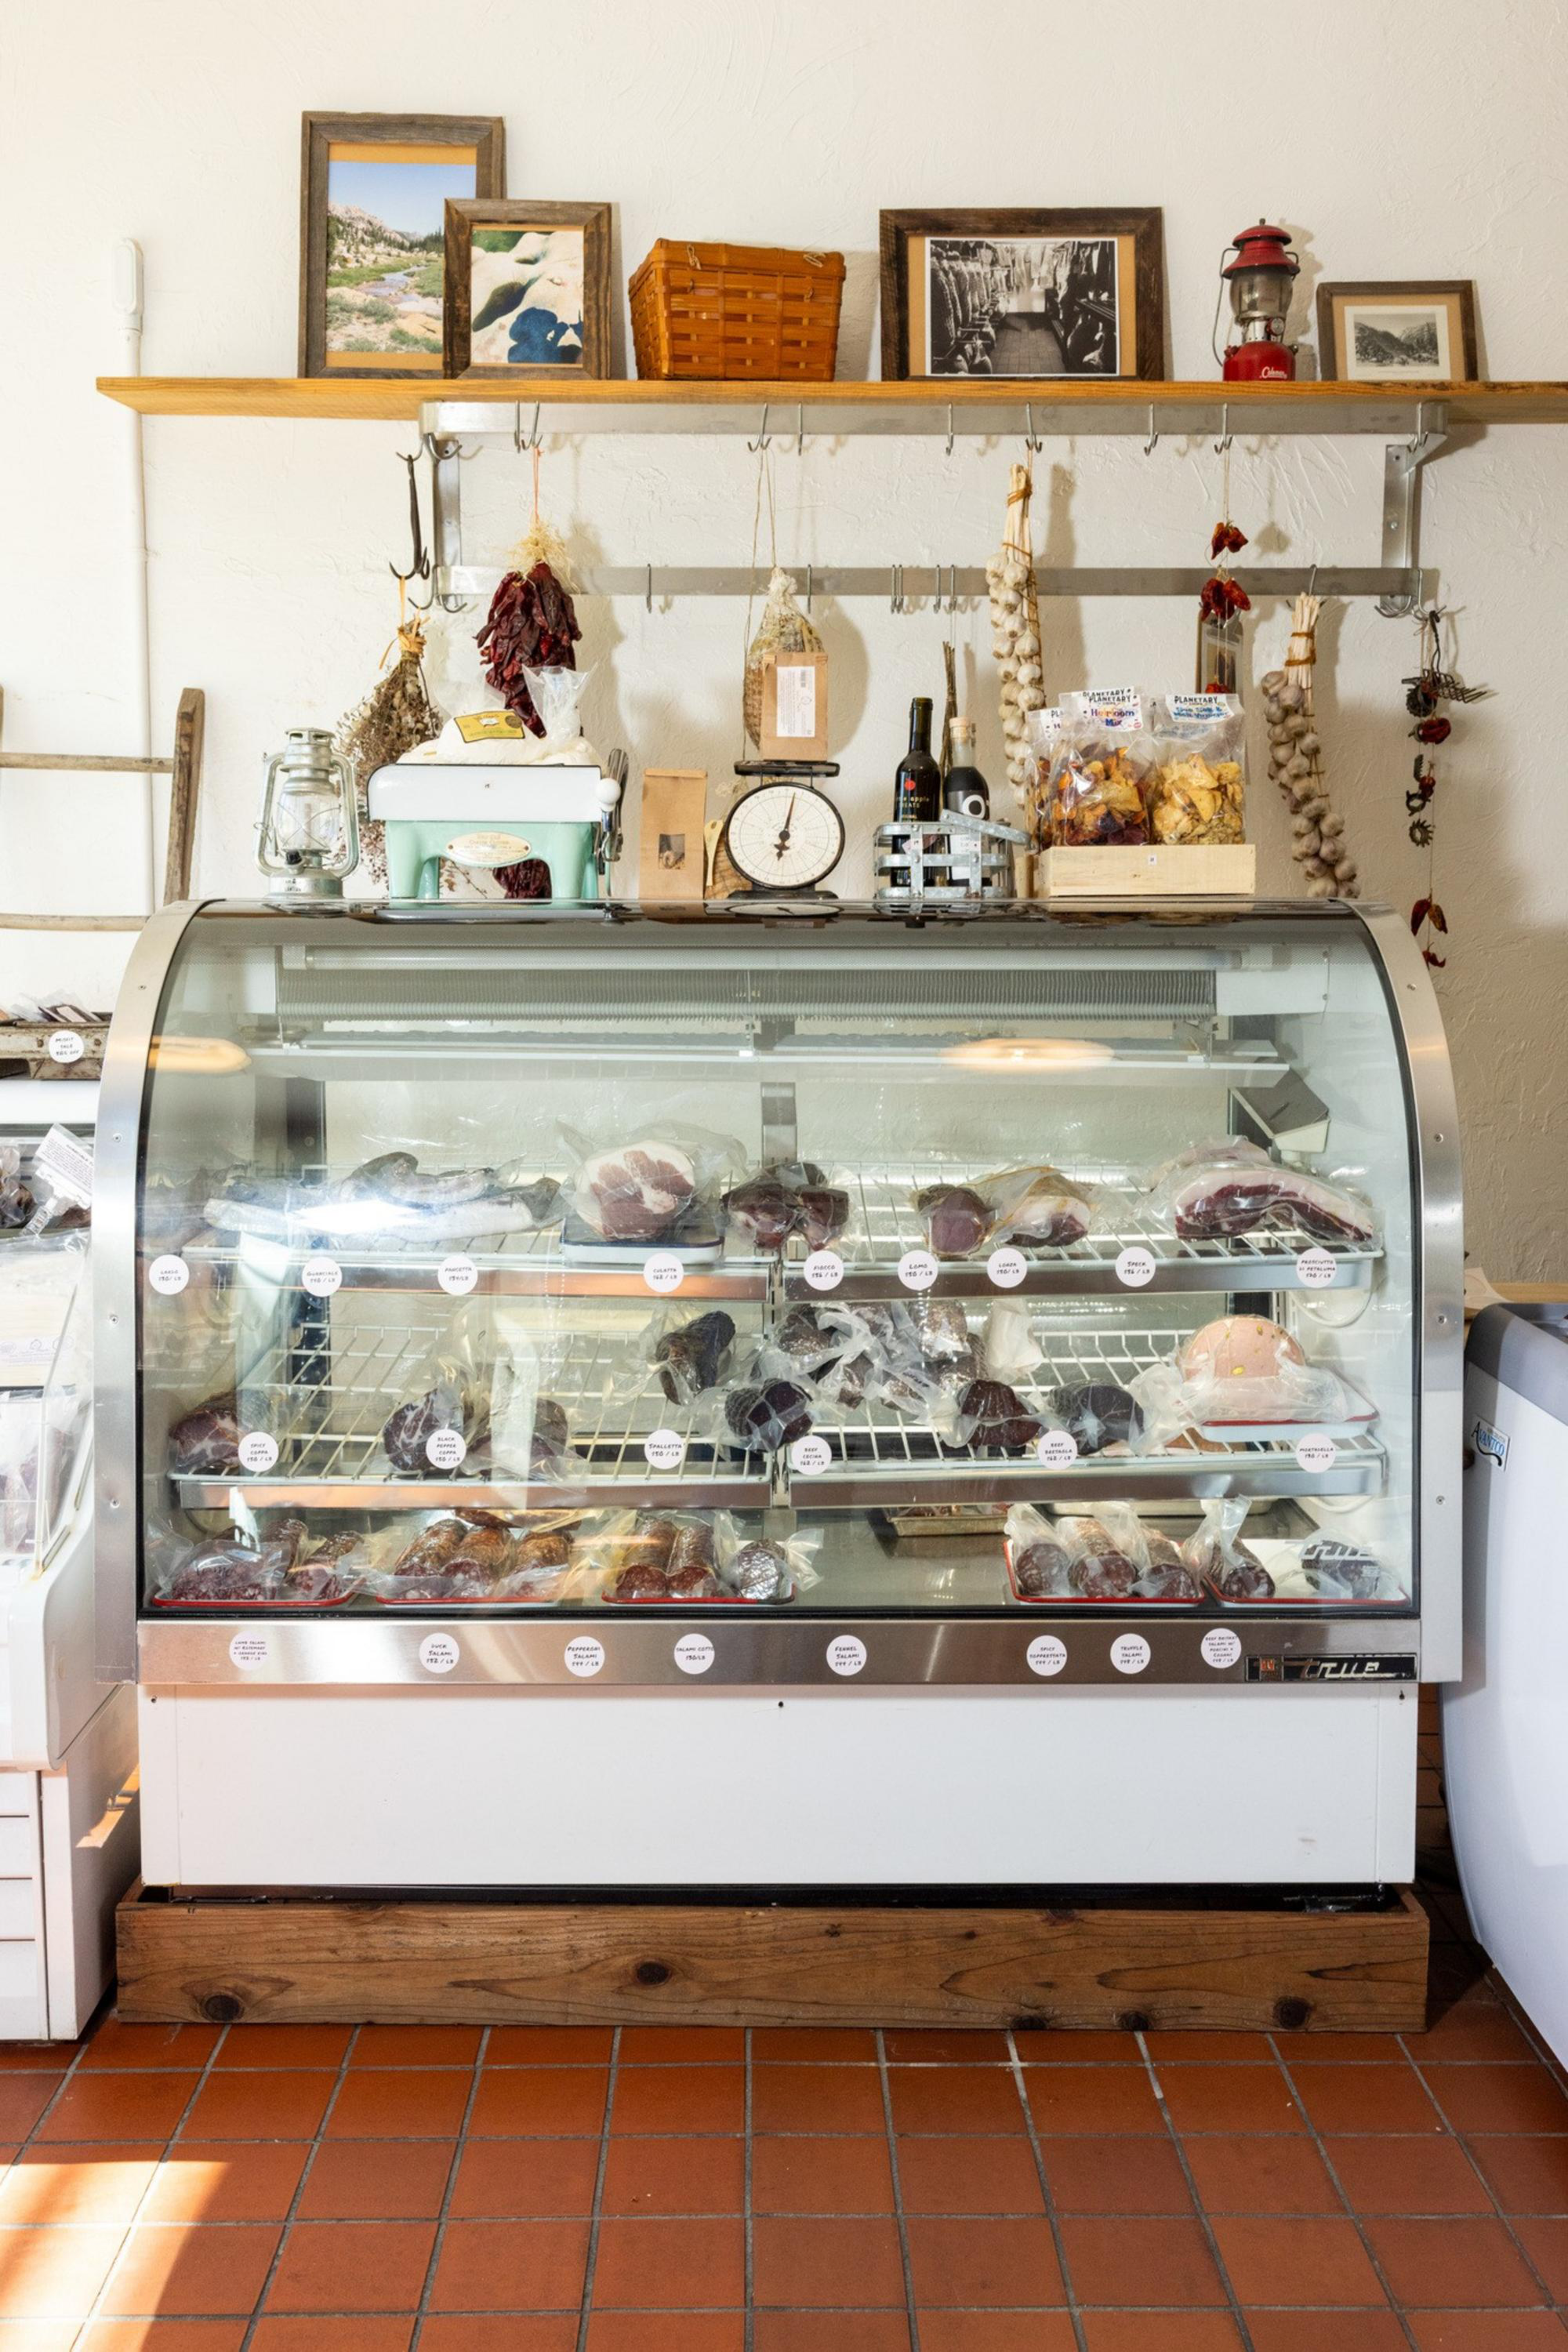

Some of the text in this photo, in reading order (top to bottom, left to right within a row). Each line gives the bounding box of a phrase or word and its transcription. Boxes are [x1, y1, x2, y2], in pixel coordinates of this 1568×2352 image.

[1091, 708, 1135, 717] Heirloom
[1105, 718, 1122, 727] Mix
[1471, 1422, 1504, 1459] AVANTCO
